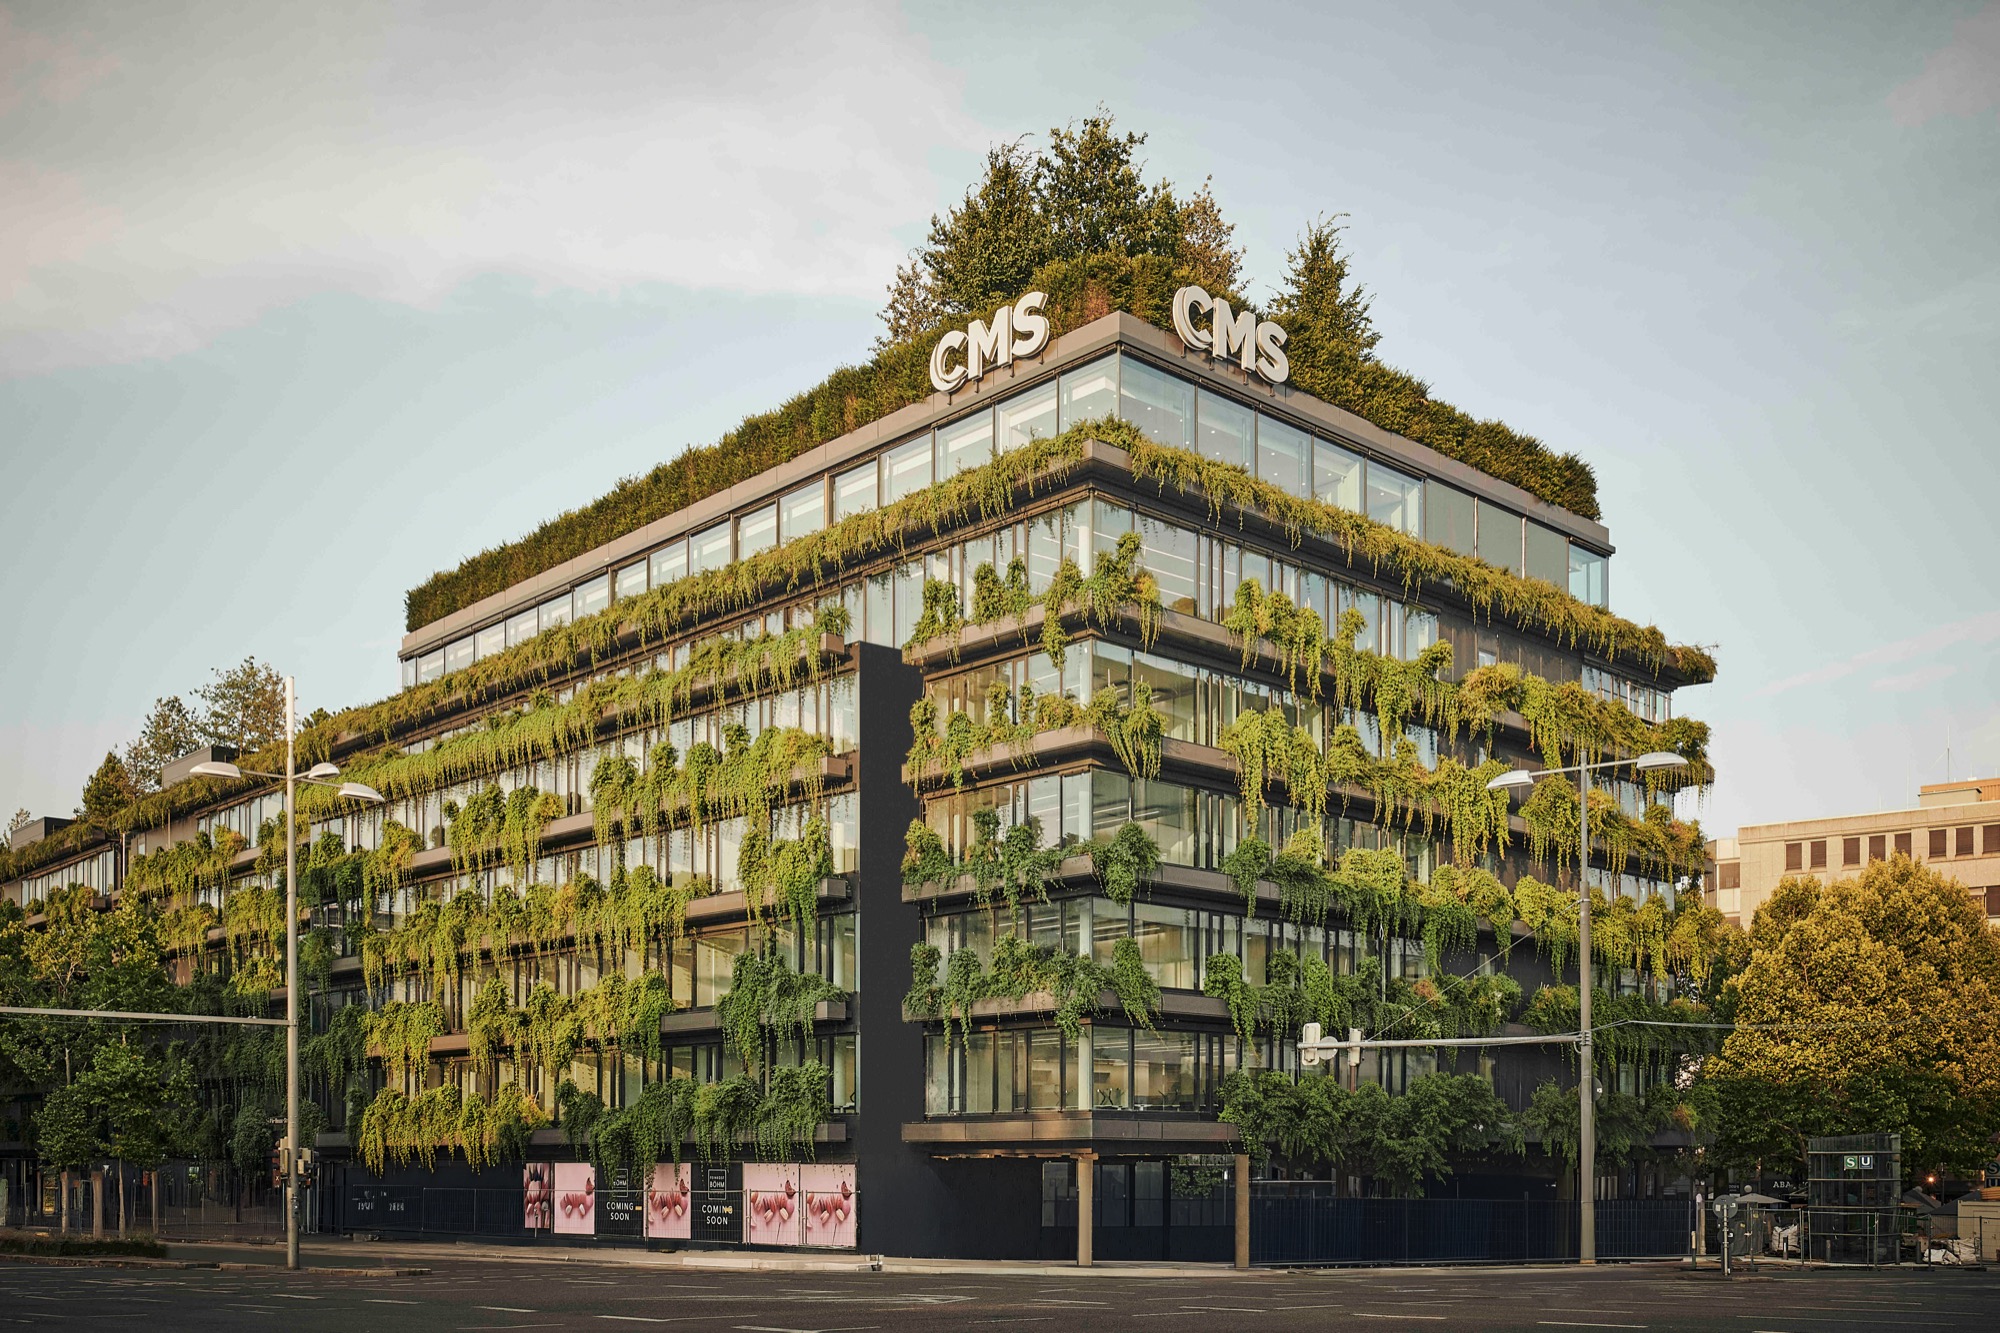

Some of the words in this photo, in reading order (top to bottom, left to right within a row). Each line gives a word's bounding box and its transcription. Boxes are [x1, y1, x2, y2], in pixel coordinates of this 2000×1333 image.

[1172, 285, 1290, 384] CMS
[930, 291, 1050, 393] CMS
[1846, 1157, 1856, 1168] S
[1861, 1156, 1870, 1166] U
[1988, 1162, 1998, 1174] S
[606, 1201, 633, 1211] COMING
[701, 1204, 733, 1214] COMING
[610, 1212, 630, 1221] SOON
[706, 1215, 728, 1225] SOON
